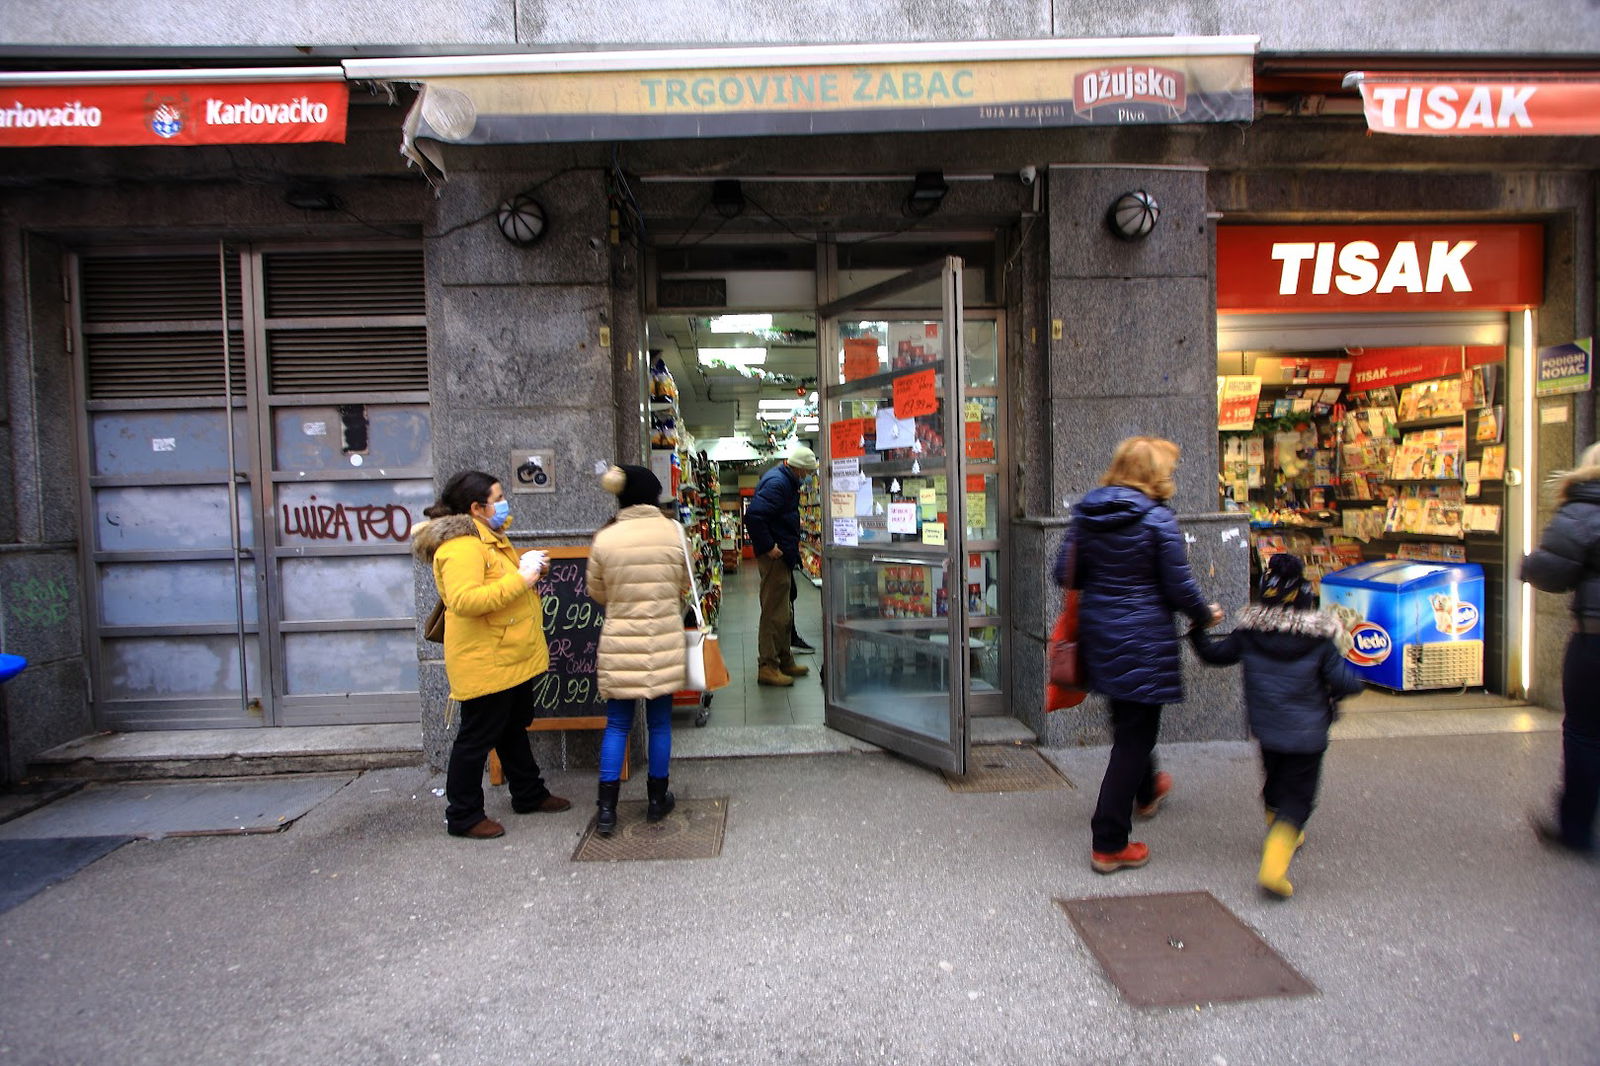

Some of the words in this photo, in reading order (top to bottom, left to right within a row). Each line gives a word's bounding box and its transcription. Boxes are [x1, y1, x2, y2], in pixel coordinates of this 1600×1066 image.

[640, 74, 840, 107] TRGOVINE
[853, 68, 975, 102] ŽABAC
[1083, 66, 1176, 104] Ožujsko
[206, 97, 328, 125] Karlovačko
[1371, 86, 1538, 129] TISAK
[1271, 241, 1478, 295] TISAK
[1356, 367, 1388, 383] TISAK
[1542, 363, 1585, 379] NOVAC
